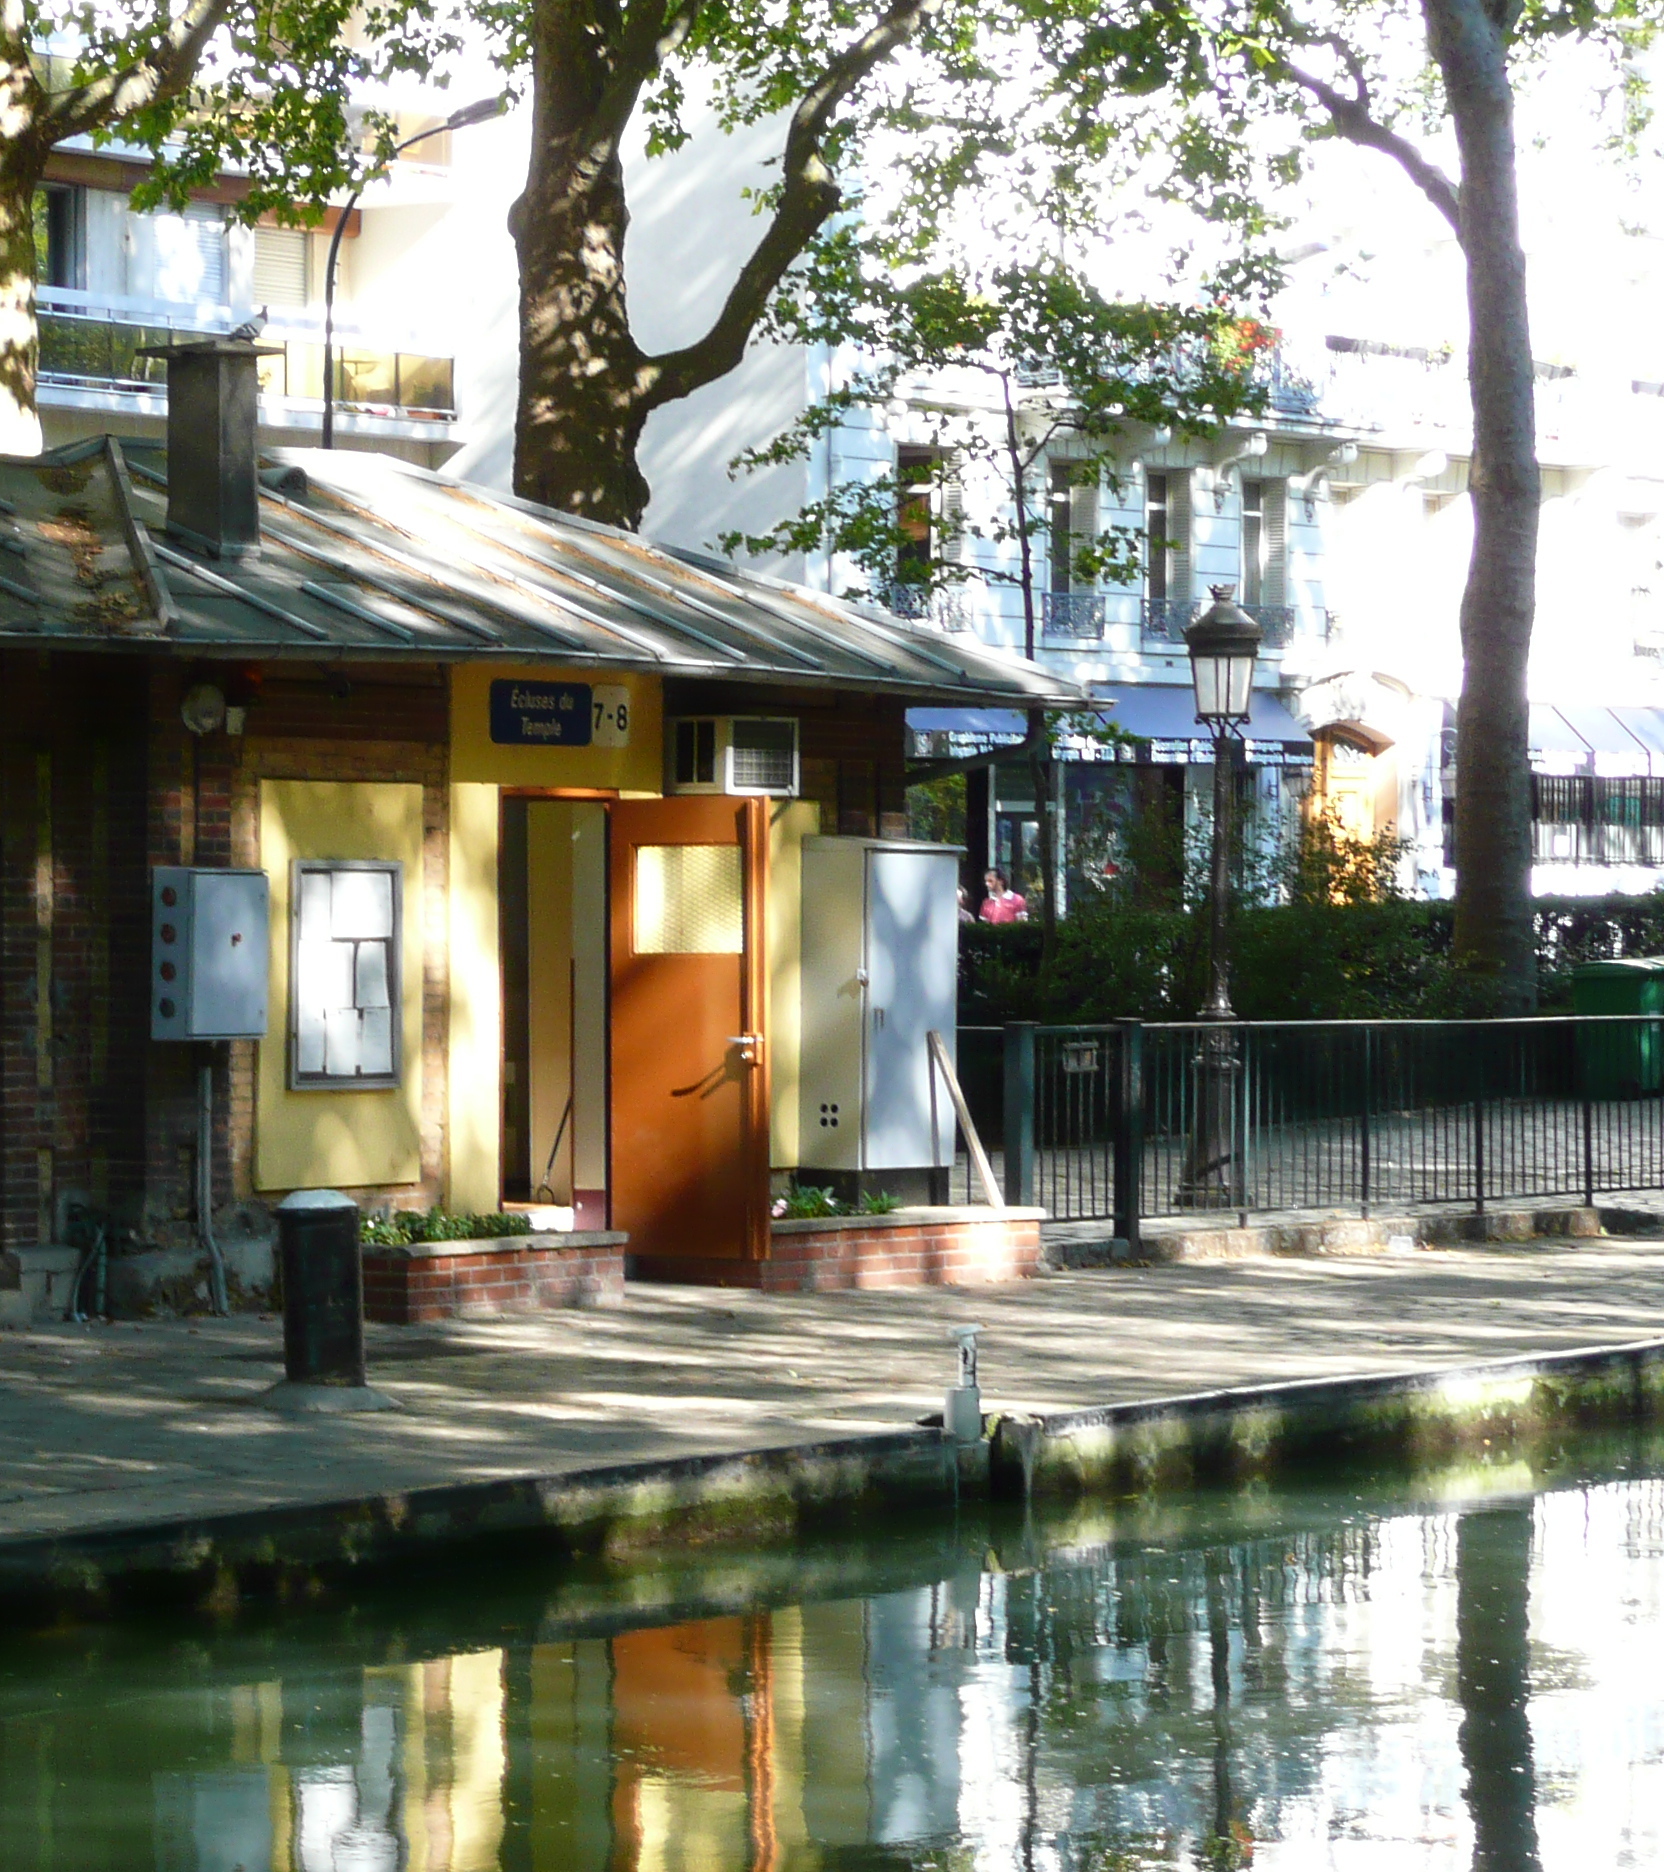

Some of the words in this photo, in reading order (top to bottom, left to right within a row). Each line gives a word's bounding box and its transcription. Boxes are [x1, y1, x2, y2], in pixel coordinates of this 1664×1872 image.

[559, 692, 575, 711] du
[521, 716, 562, 741] Temple
[593, 702, 628, 732] 7-8
